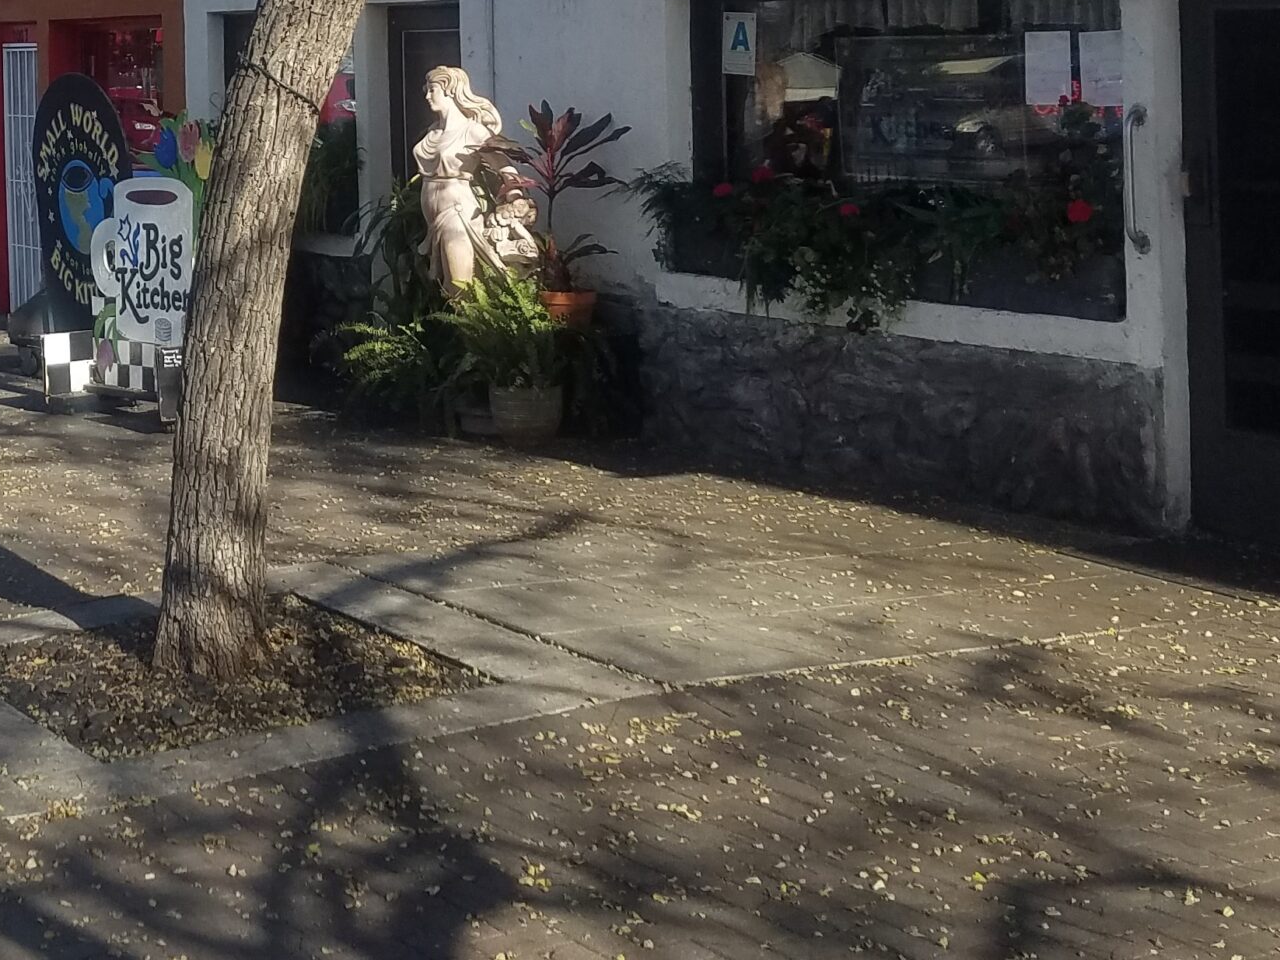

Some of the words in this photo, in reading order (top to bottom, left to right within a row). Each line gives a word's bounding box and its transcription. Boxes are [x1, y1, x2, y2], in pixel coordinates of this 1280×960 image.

[730, 21, 751, 52] A
[37, 109, 67, 182] SMALL
[70, 102, 119, 166] WORLD
[50, 246, 74, 291] BIG
[139, 222, 183, 281] Big
